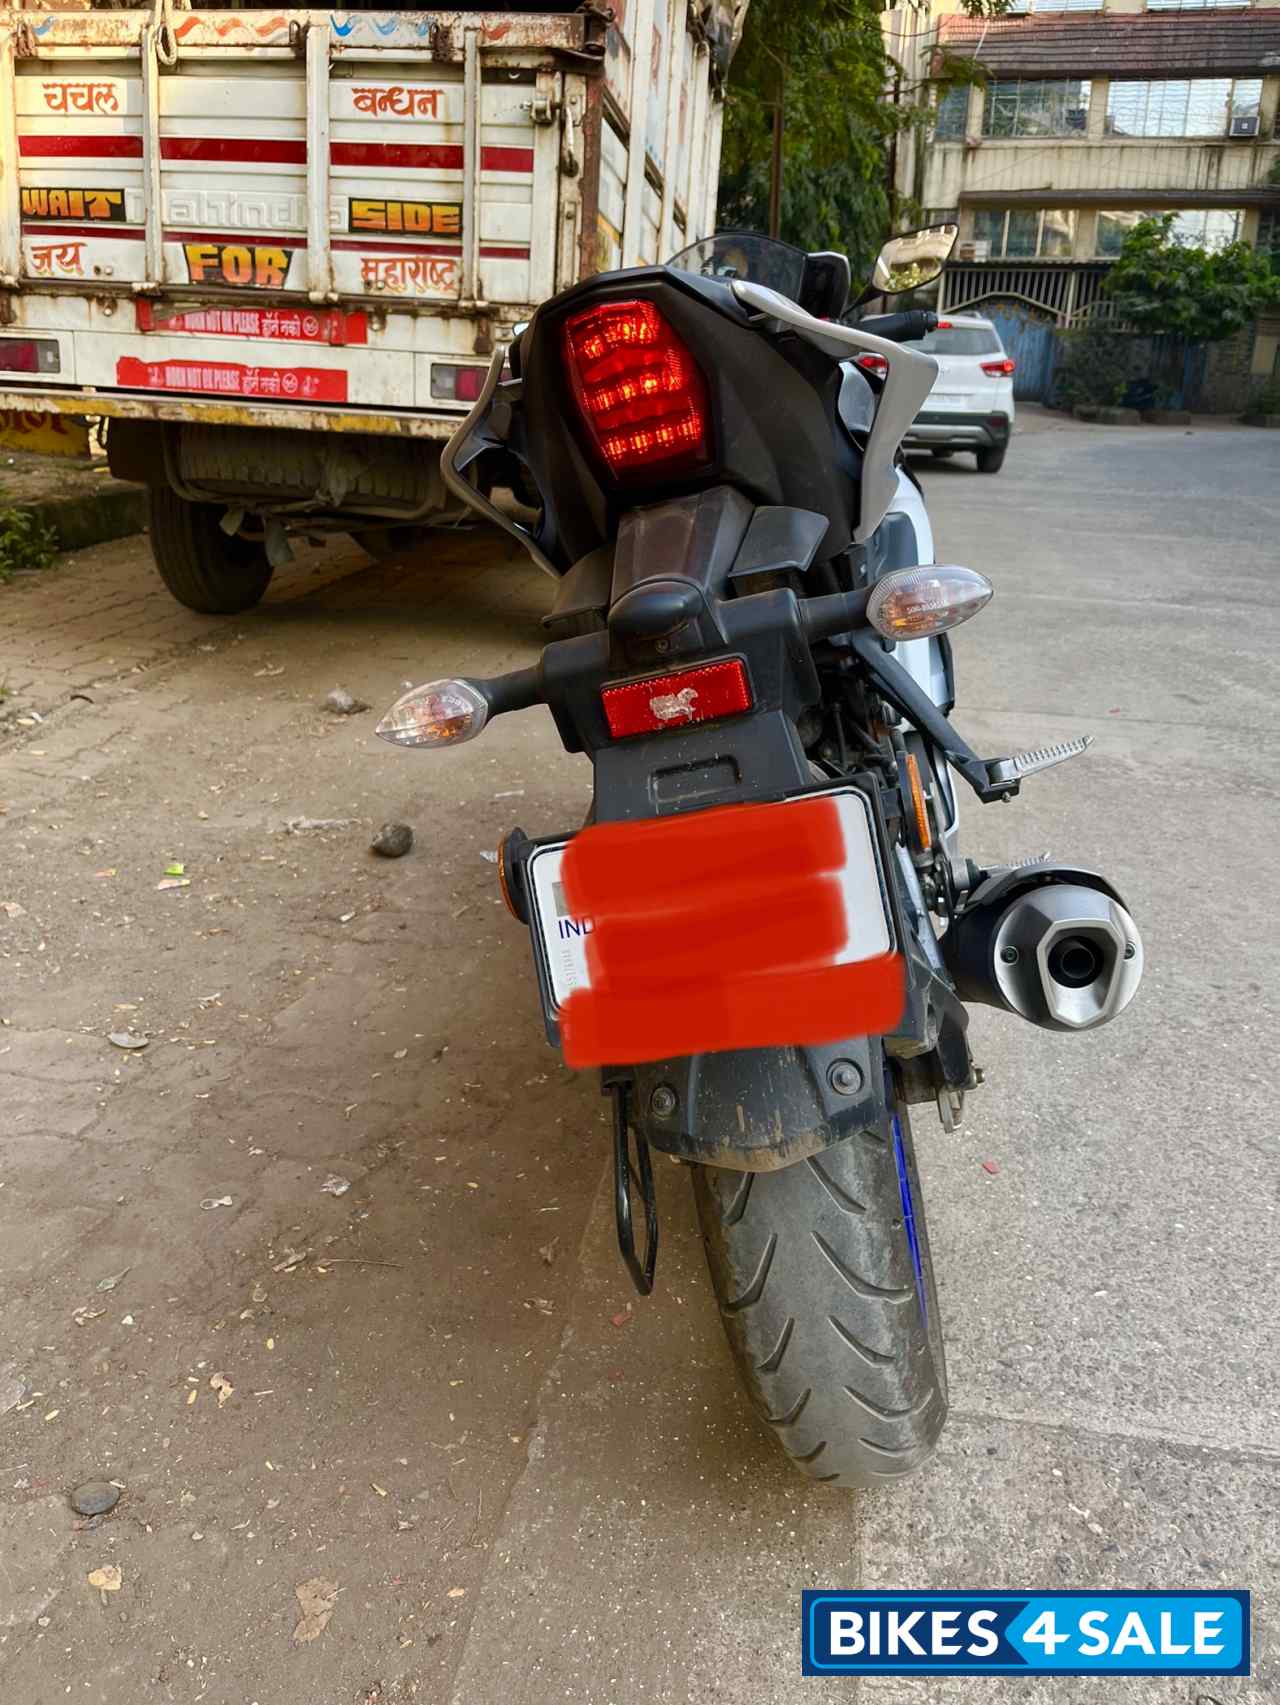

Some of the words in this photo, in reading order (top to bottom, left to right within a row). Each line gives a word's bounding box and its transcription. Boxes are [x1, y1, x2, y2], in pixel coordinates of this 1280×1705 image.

[352, 86, 445, 119] बन्धन
[22, 189, 122, 218] WAIT
[351, 200, 460, 233] SIDE
[31, 242, 87, 276] जय
[185, 244, 289, 287] FOR
[558, 918, 596, 939] IND
